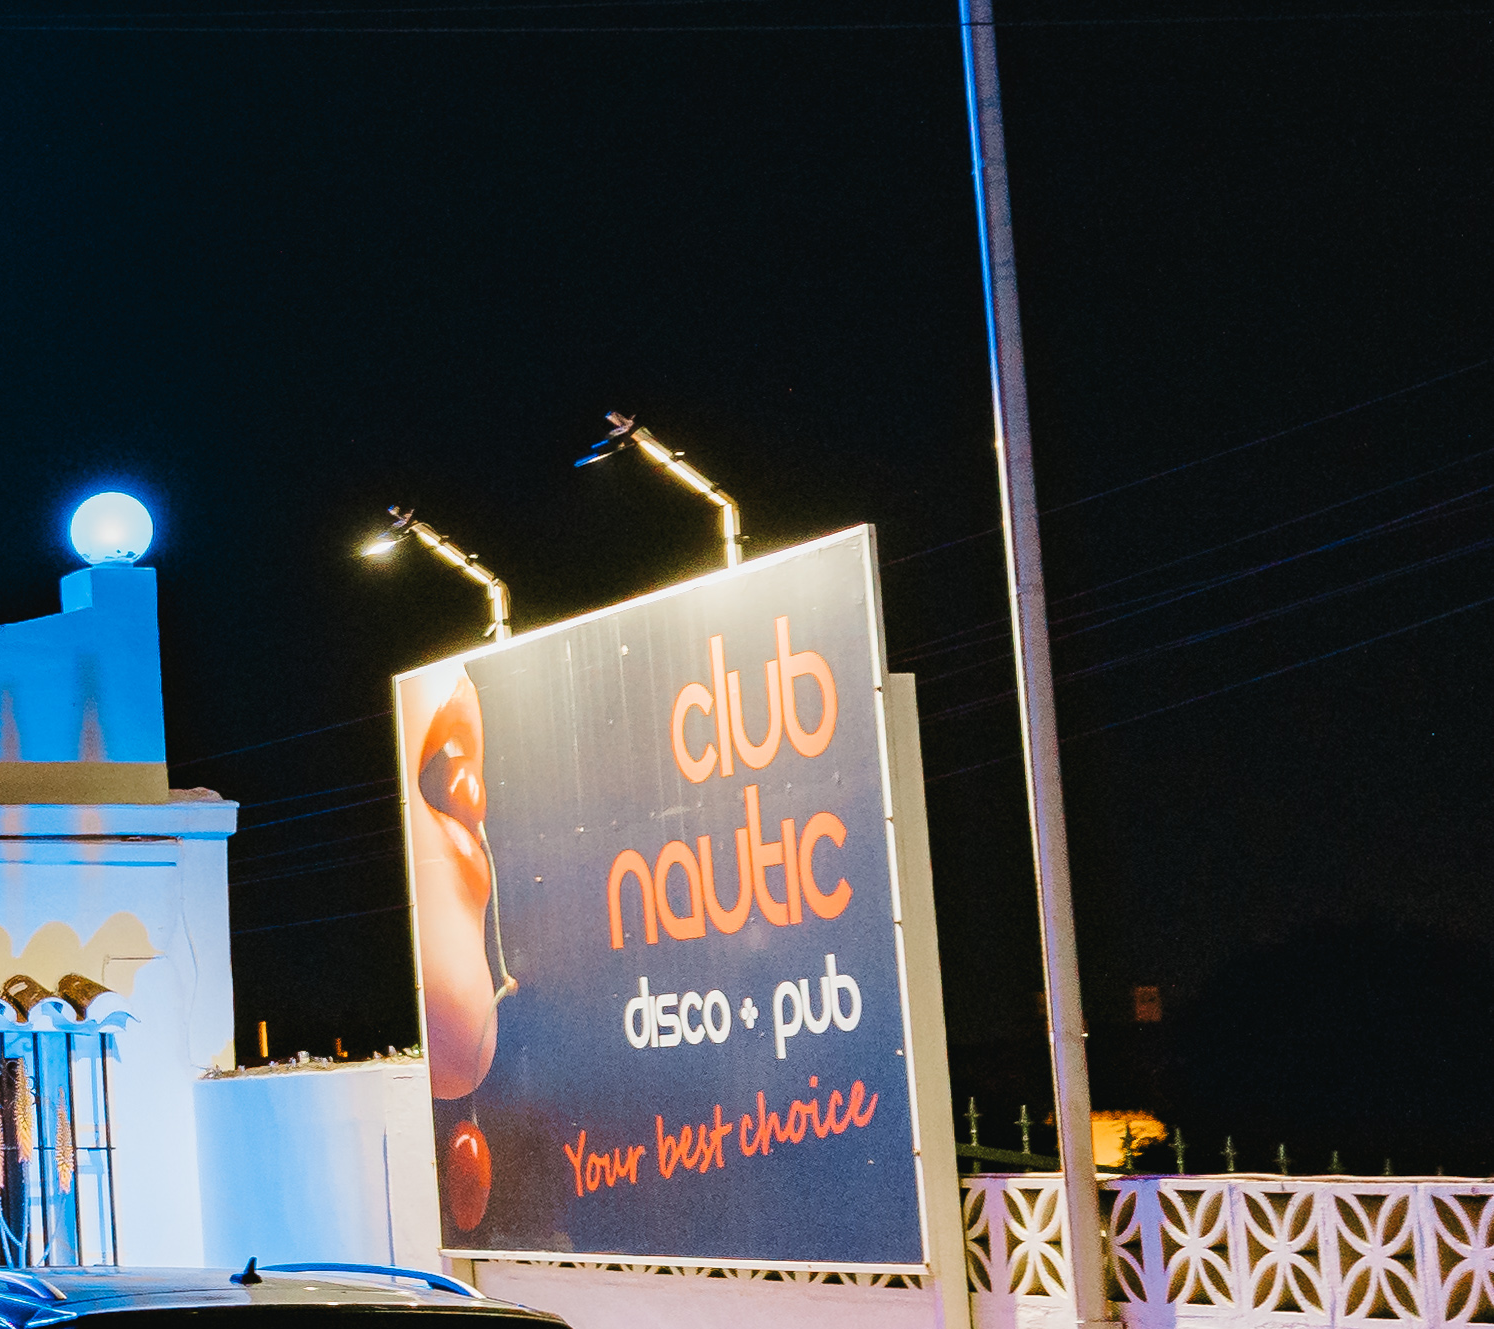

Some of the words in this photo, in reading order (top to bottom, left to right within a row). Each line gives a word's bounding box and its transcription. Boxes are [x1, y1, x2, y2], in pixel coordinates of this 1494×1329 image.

[670, 616, 839, 784] club
[607, 784, 854, 950] nautic
[624, 977, 732, 1049] disco
[773, 953, 862, 1060] pub
[563, 1130, 646, 1197] Your
[654, 1106, 733, 1180] best
[738, 1076, 879, 1159] choice
